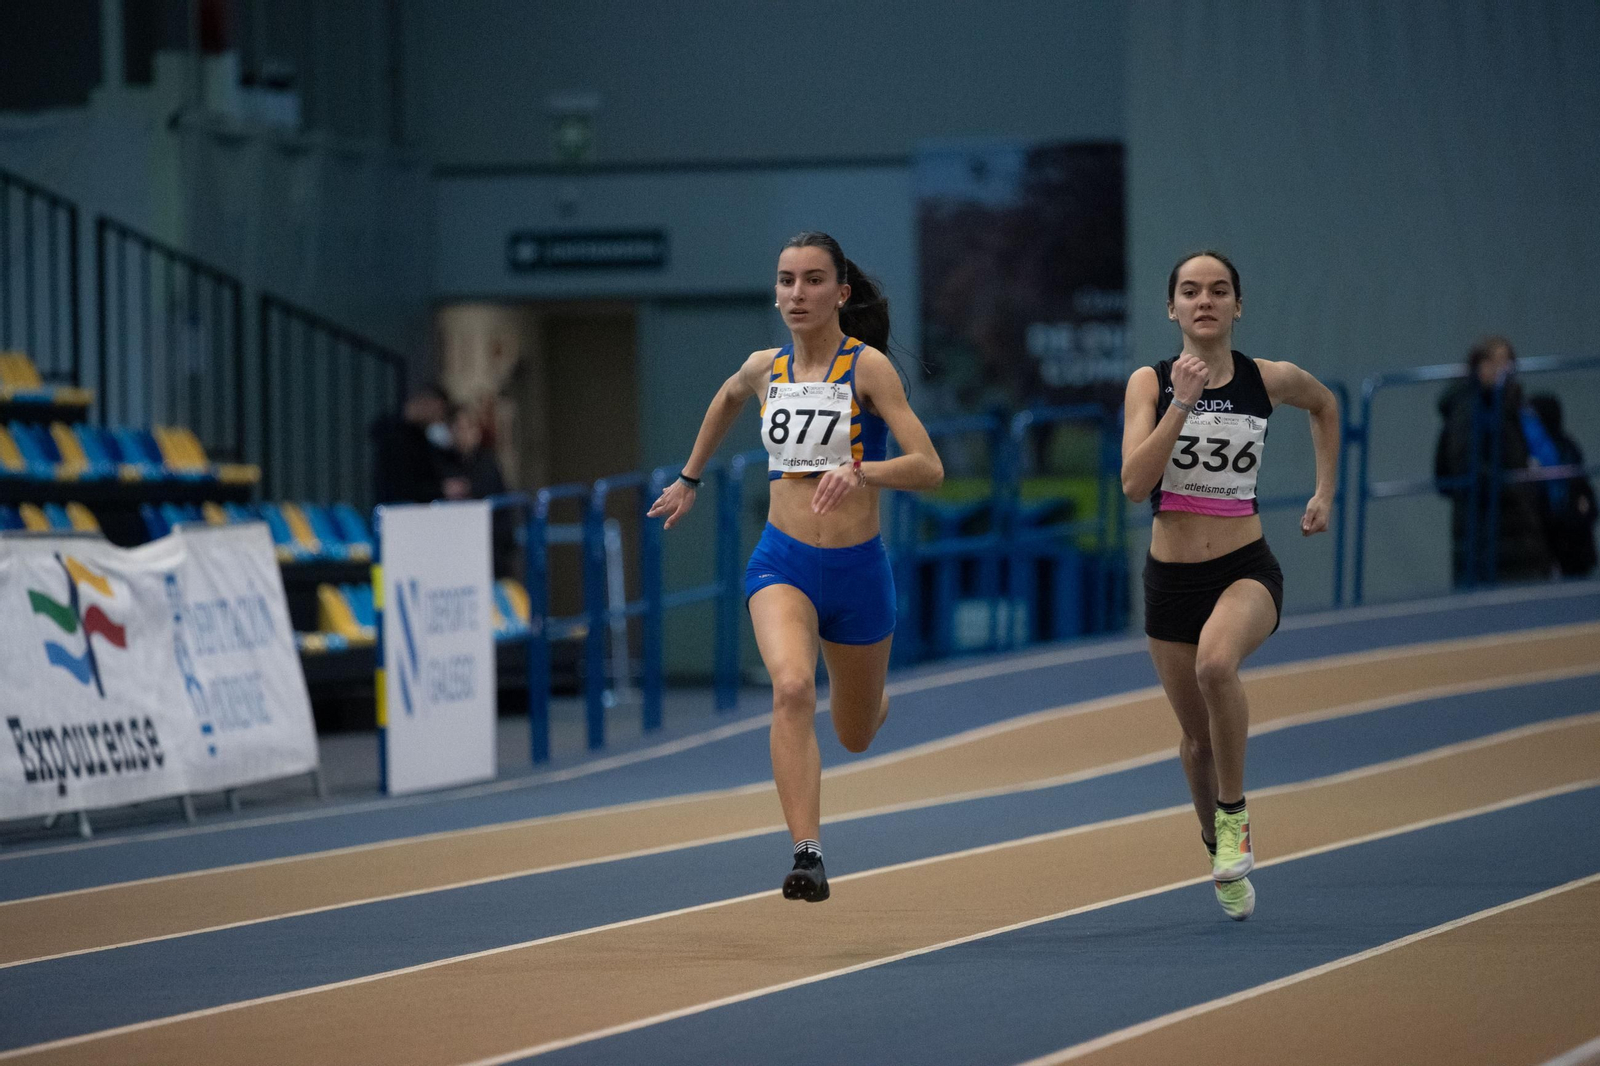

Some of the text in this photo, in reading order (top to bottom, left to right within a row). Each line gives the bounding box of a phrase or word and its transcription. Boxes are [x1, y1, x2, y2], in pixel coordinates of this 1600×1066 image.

[768, 408, 842, 446] 877
[782, 457, 828, 467] etismo.gal
[1171, 434, 1258, 474] 336
[1184, 482, 1239, 496] atletismo.gal
[7, 716, 165, 797] Expourense
